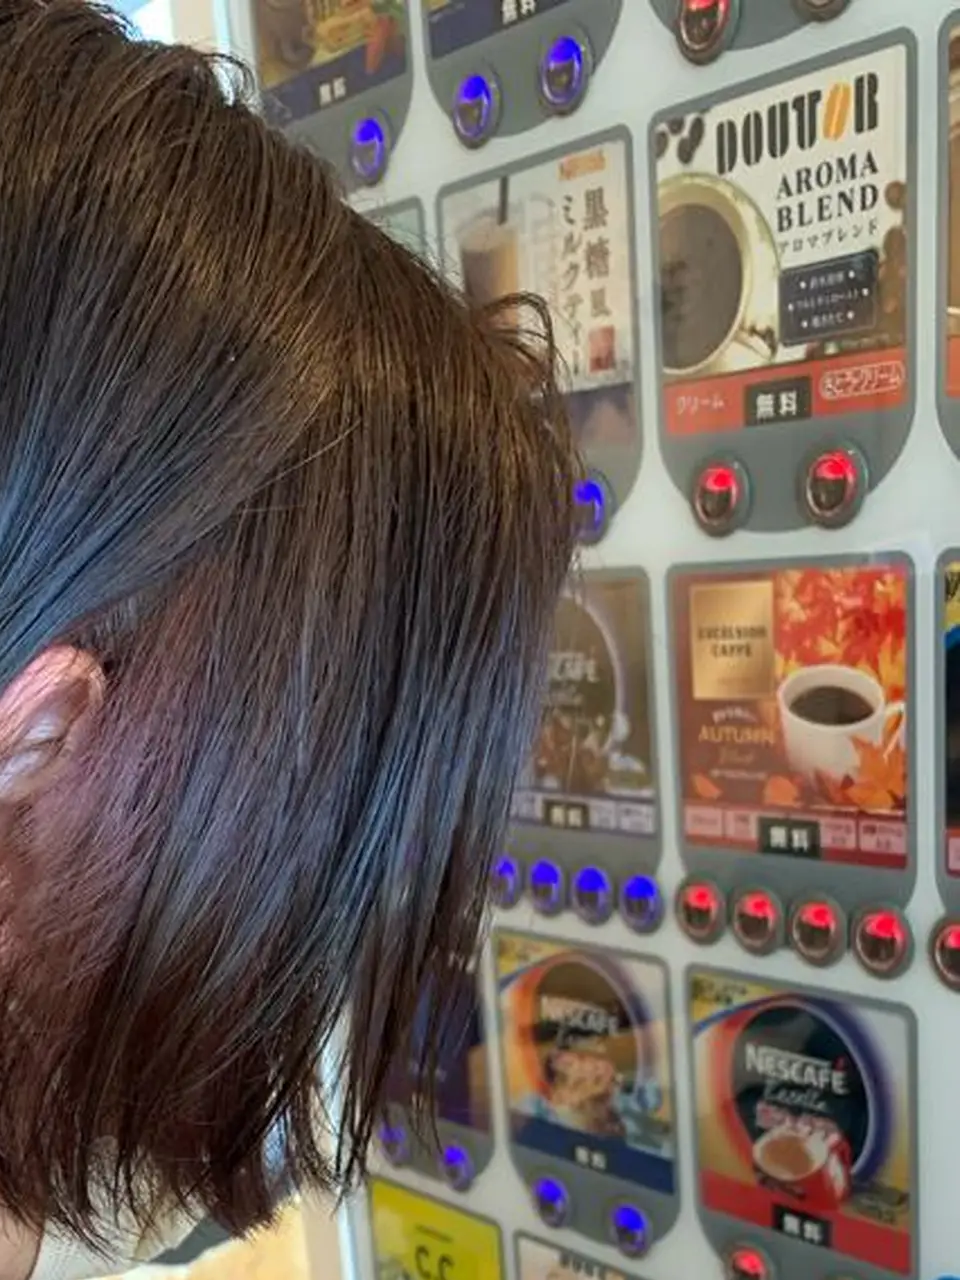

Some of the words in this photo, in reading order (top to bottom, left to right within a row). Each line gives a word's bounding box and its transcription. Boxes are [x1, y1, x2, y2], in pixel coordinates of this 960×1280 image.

[716, 72, 878, 176] DOUTOR
[776, 149, 878, 201] AROMA
[777, 183, 878, 233] BLEND
[778, 217, 878, 253] アロマブレンド
[755, 390, 797, 421] 無料
